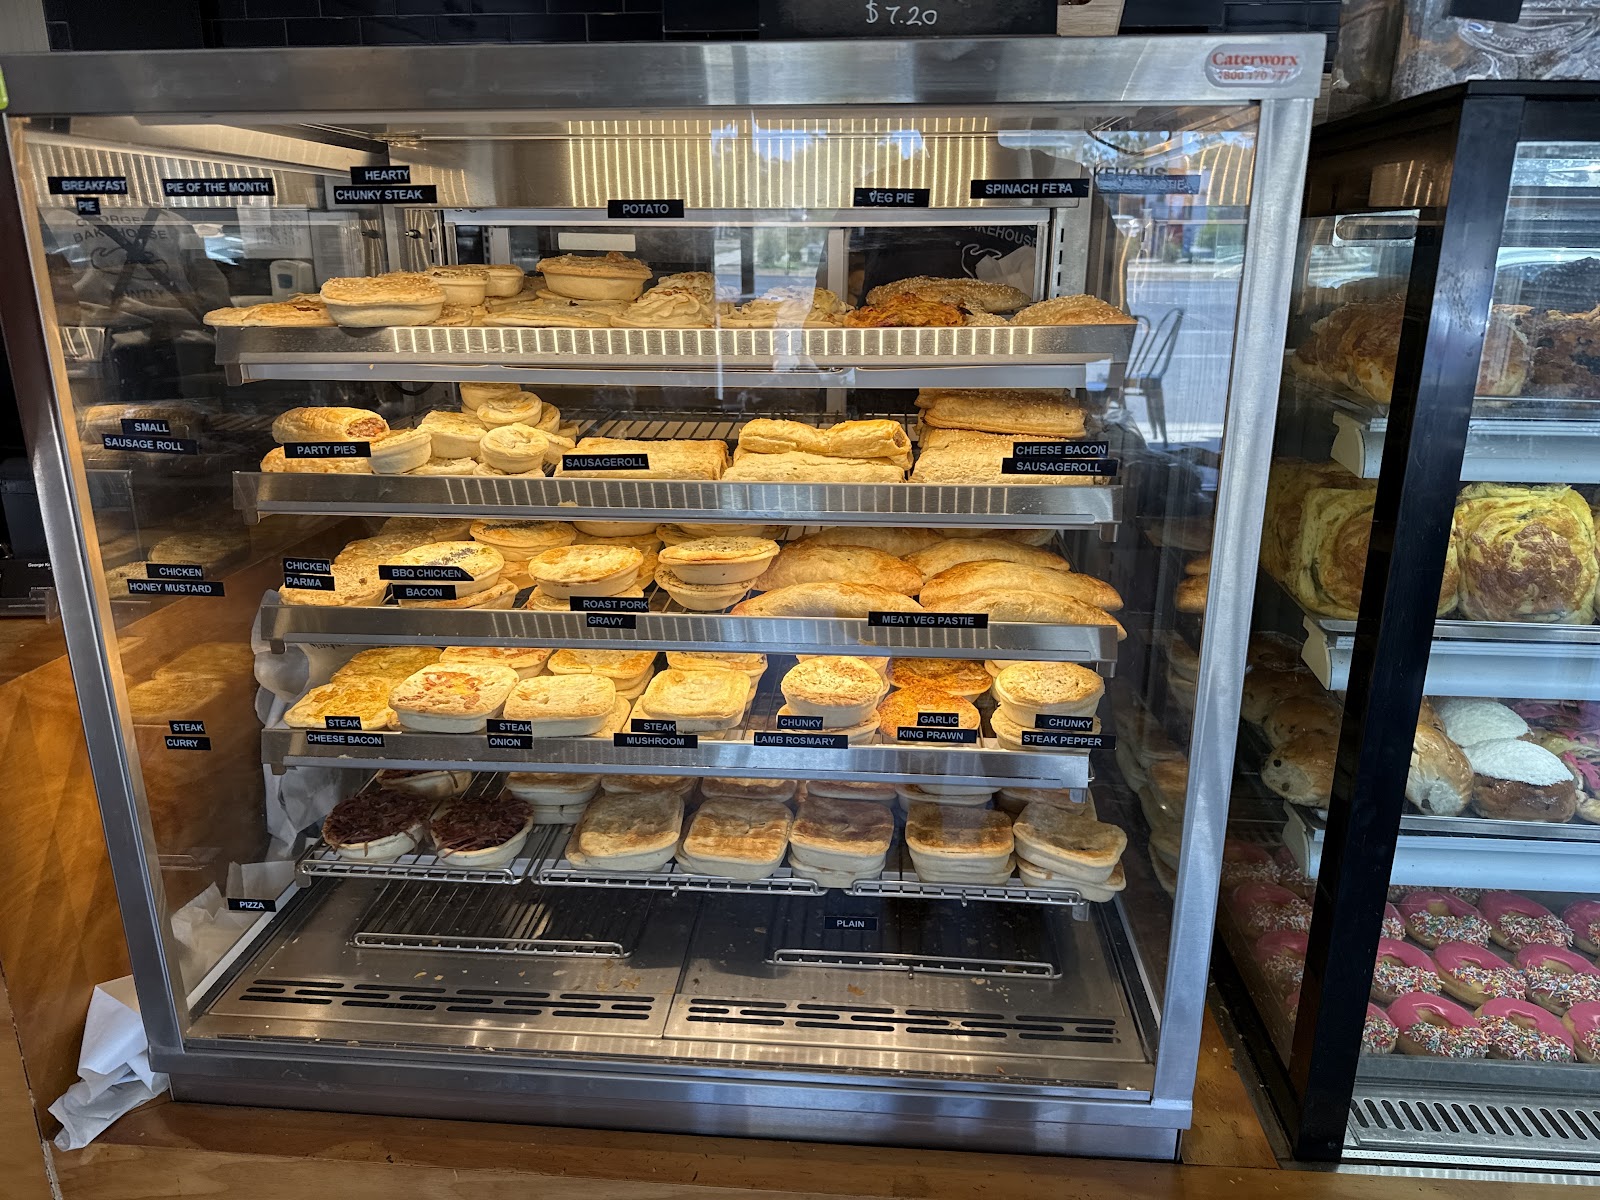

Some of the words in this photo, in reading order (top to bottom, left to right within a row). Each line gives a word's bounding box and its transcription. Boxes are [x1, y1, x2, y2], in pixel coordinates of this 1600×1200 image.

[1211, 52, 1298, 66] Caterworx
[365, 170, 409, 180] HEARTY
[61, 180, 126, 191] BREAKFAST
[166, 182, 184, 193] PIE
[187, 182, 201, 193] OF
[203, 182, 226, 193] THE
[229, 182, 269, 193] MONTH
[985, 183, 1039, 194] SPINACH
[336, 190, 382, 200] CHUNKY
[384, 189, 423, 200] STEAK
[869, 191, 893, 203] VEG
[896, 192, 915, 203] PIE
[78, 201, 96, 211] PIE
[622, 203, 669, 214] POTATO
[134, 421, 170, 433] SMALL
[104, 437, 154, 449] SAUSAGE
[156, 440, 184, 451] ROLL
[296, 445, 331, 455] PARTY
[333, 445, 357, 455] PIES
[1016, 445, 1062, 455] CHEESE
[1065, 444, 1106, 455] BACON
[565, 457, 646, 468] SAUSAGEROLL
[1016, 461, 1102, 472] SAUSAGEROLL
[285, 561, 330, 572] CHICKEN
[159, 567, 203, 577] CHICKEN
[392, 568, 414, 578] BBQ
[416, 568, 462, 578] CHICKEN
[286, 577, 322, 587] PARMA
[129, 582, 162, 592] HONEY
[165, 583, 212, 594] MUSTARD
[405, 587, 443, 597] BACON
[582, 599, 617, 609] ROAST
[620, 600, 649, 609] PORK
[587, 616, 624, 626] GRAVY
[882, 615, 911, 624] MEAT
[913, 616, 935, 625] VEG
[938, 616, 975, 626] PASTIE
[328, 719, 361, 728] STEAK
[780, 718, 822, 728] CHUNKY
[920, 715, 959, 724] GARLIC
[1048, 718, 1093, 729] CHUNKY
[172, 723, 204, 732] STEAK
[499, 722, 532, 732] STEAK
[643, 722, 676, 732] STEAK
[307, 733, 346, 743] CHEESE
[347, 735, 382, 745] BACON
[899, 730, 924, 739] KING
[926, 731, 964, 740] PRAWN
[1023, 734, 1058, 744] STEAK
[1060, 736, 1102, 746] PEPPER
[166, 738, 199, 748] CURRY
[489, 737, 521, 747] ONION
[626, 736, 685, 746] MUSHROOM
[755, 735, 783, 744] LAMB
[785, 736, 835, 746] ROSMARY
[239, 901, 265, 909] PIZZA
[836, 919, 865, 928] PLAIN
